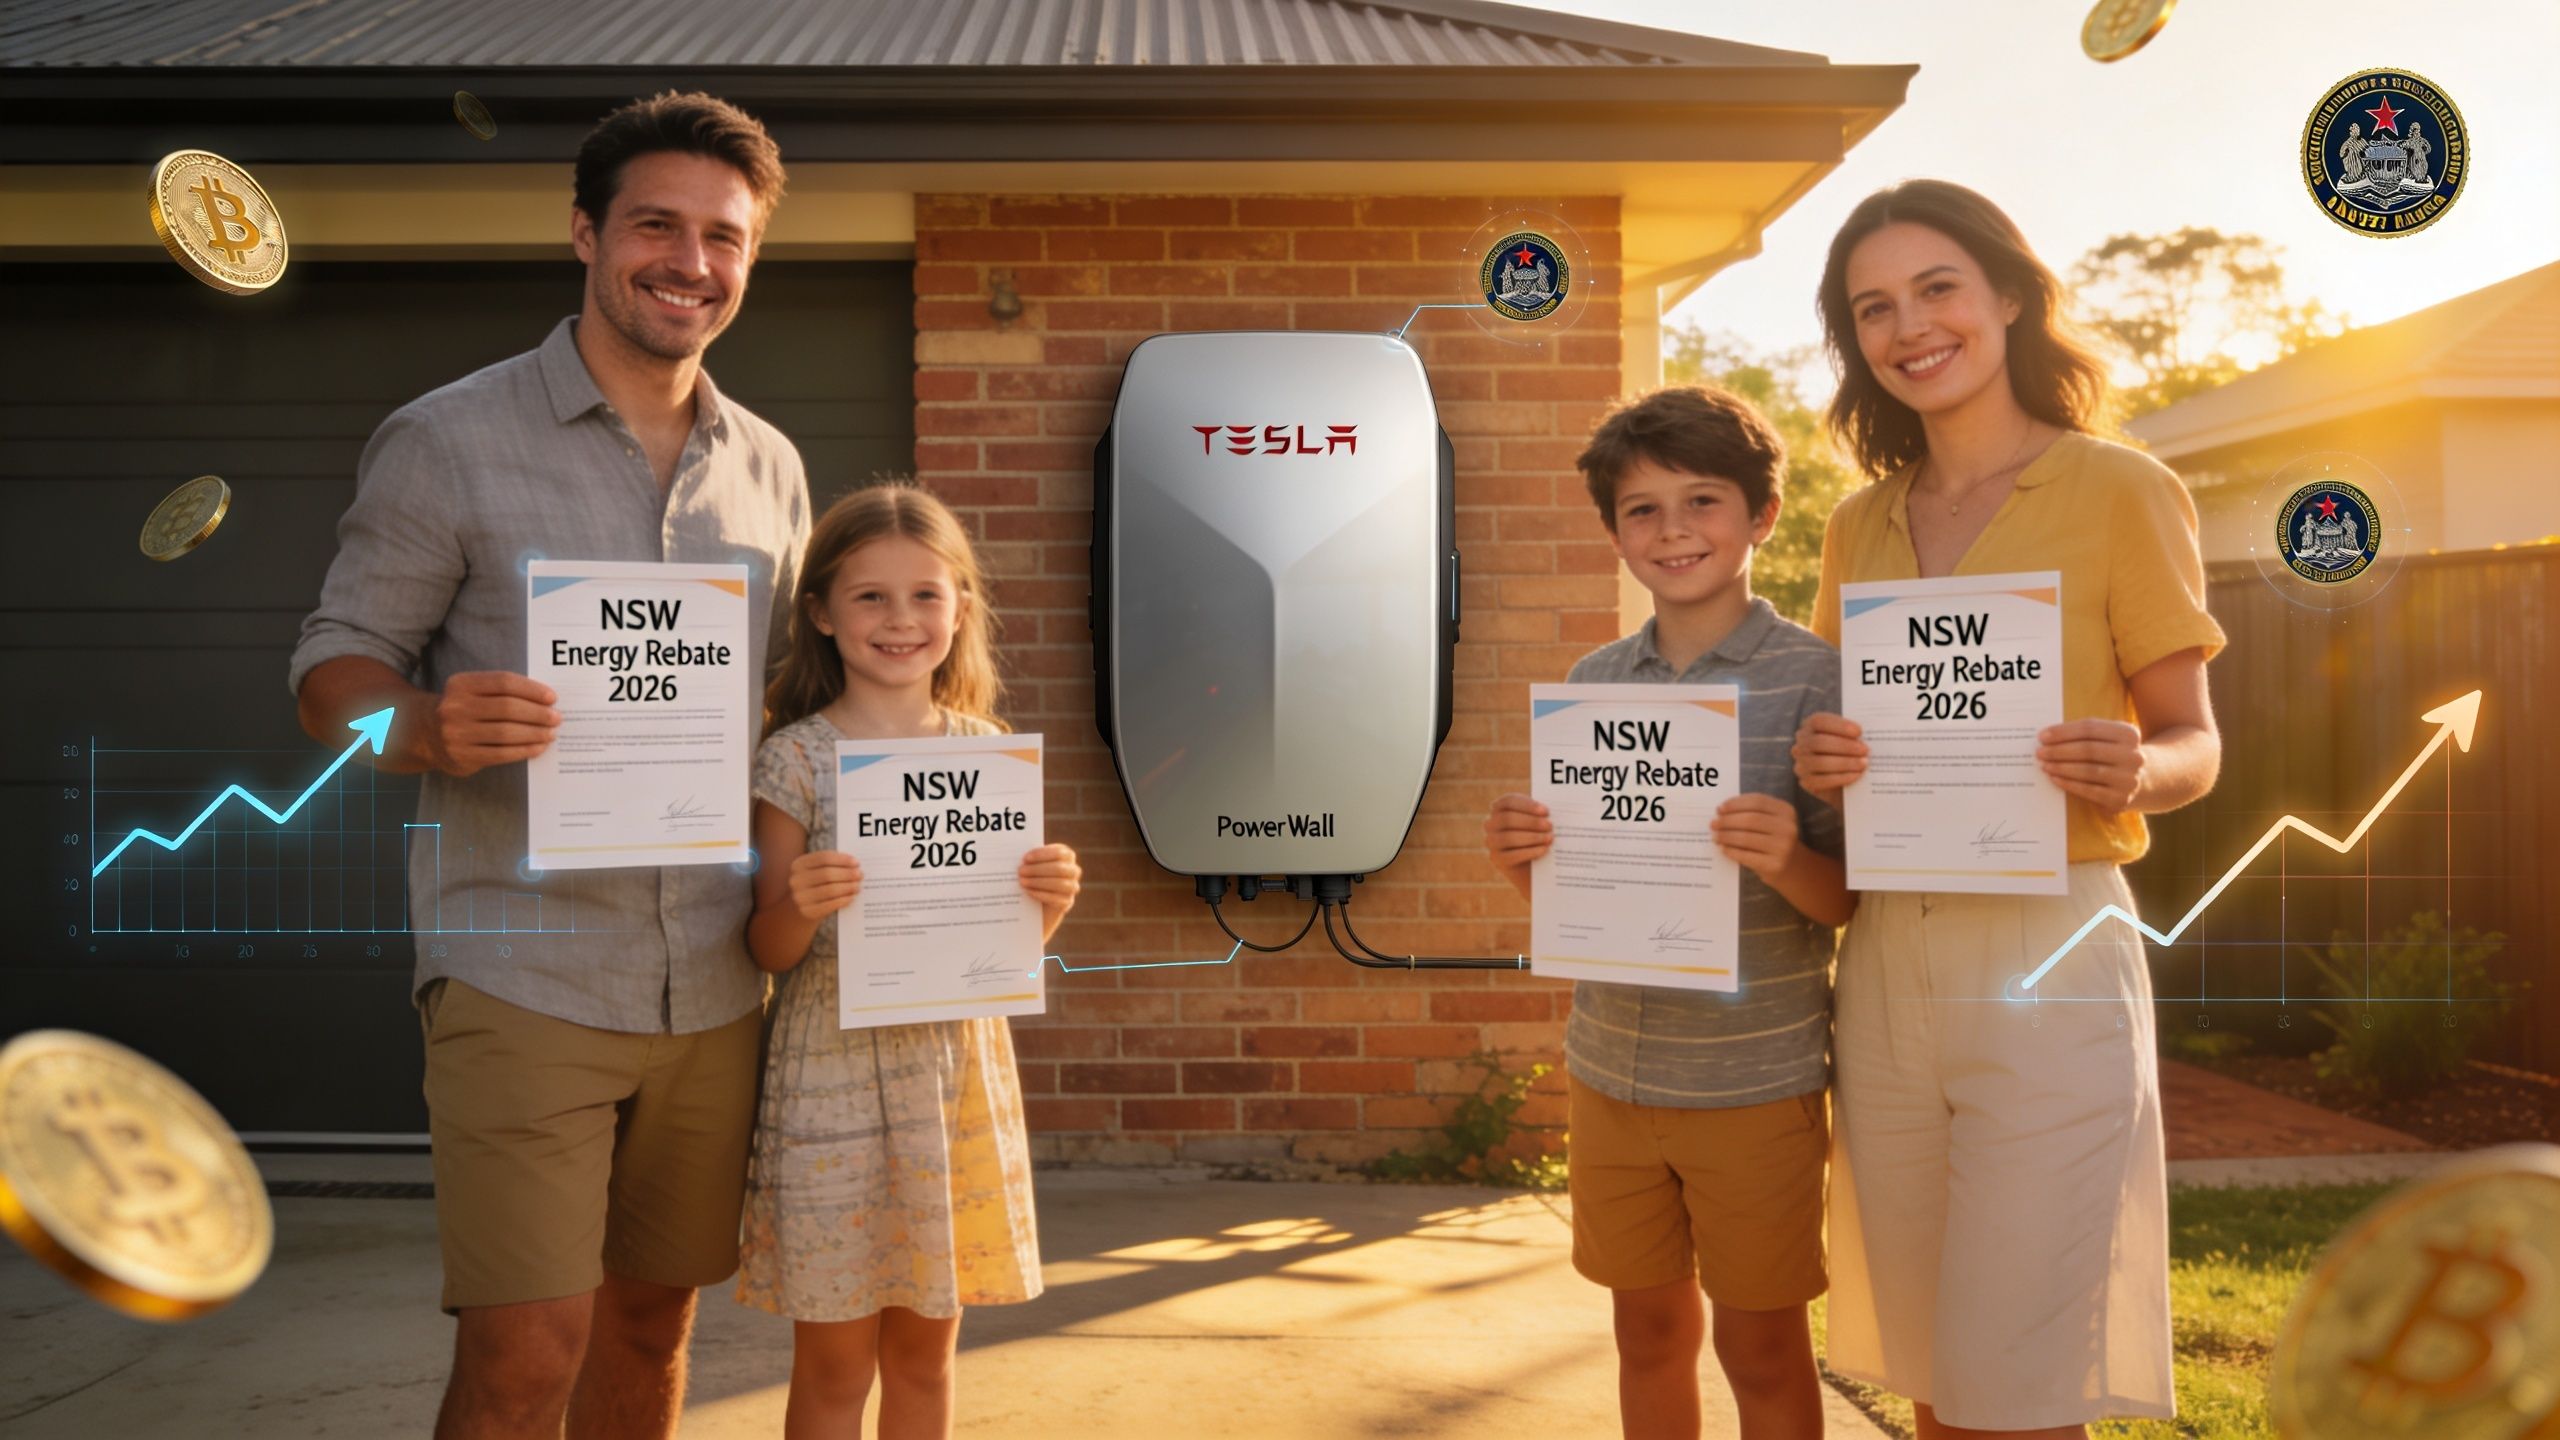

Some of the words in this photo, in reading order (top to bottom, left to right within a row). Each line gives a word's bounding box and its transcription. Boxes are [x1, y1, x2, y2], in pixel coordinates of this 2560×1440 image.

[1192, 425, 1358, 456] TESLA
[600, 598, 681, 630] NSW
[1908, 613, 1989, 647] NSW
[550, 640, 638, 671] Energy
[646, 640, 730, 665] Rebate
[608, 675, 677, 701] 2026
[1861, 660, 1944, 690] Energy
[1953, 654, 2041, 682] Rebate
[1916, 691, 1987, 720] 2026
[1593, 720, 1670, 752] NSW
[903, 770, 980, 802] NSW
[1550, 759, 1628, 792] Energy
[1636, 759, 1719, 787] Rebate
[858, 812, 939, 840] Energy
[946, 806, 1026, 834] Rebate
[1600, 796, 1665, 822] 2026
[910, 841, 976, 868] 2026
